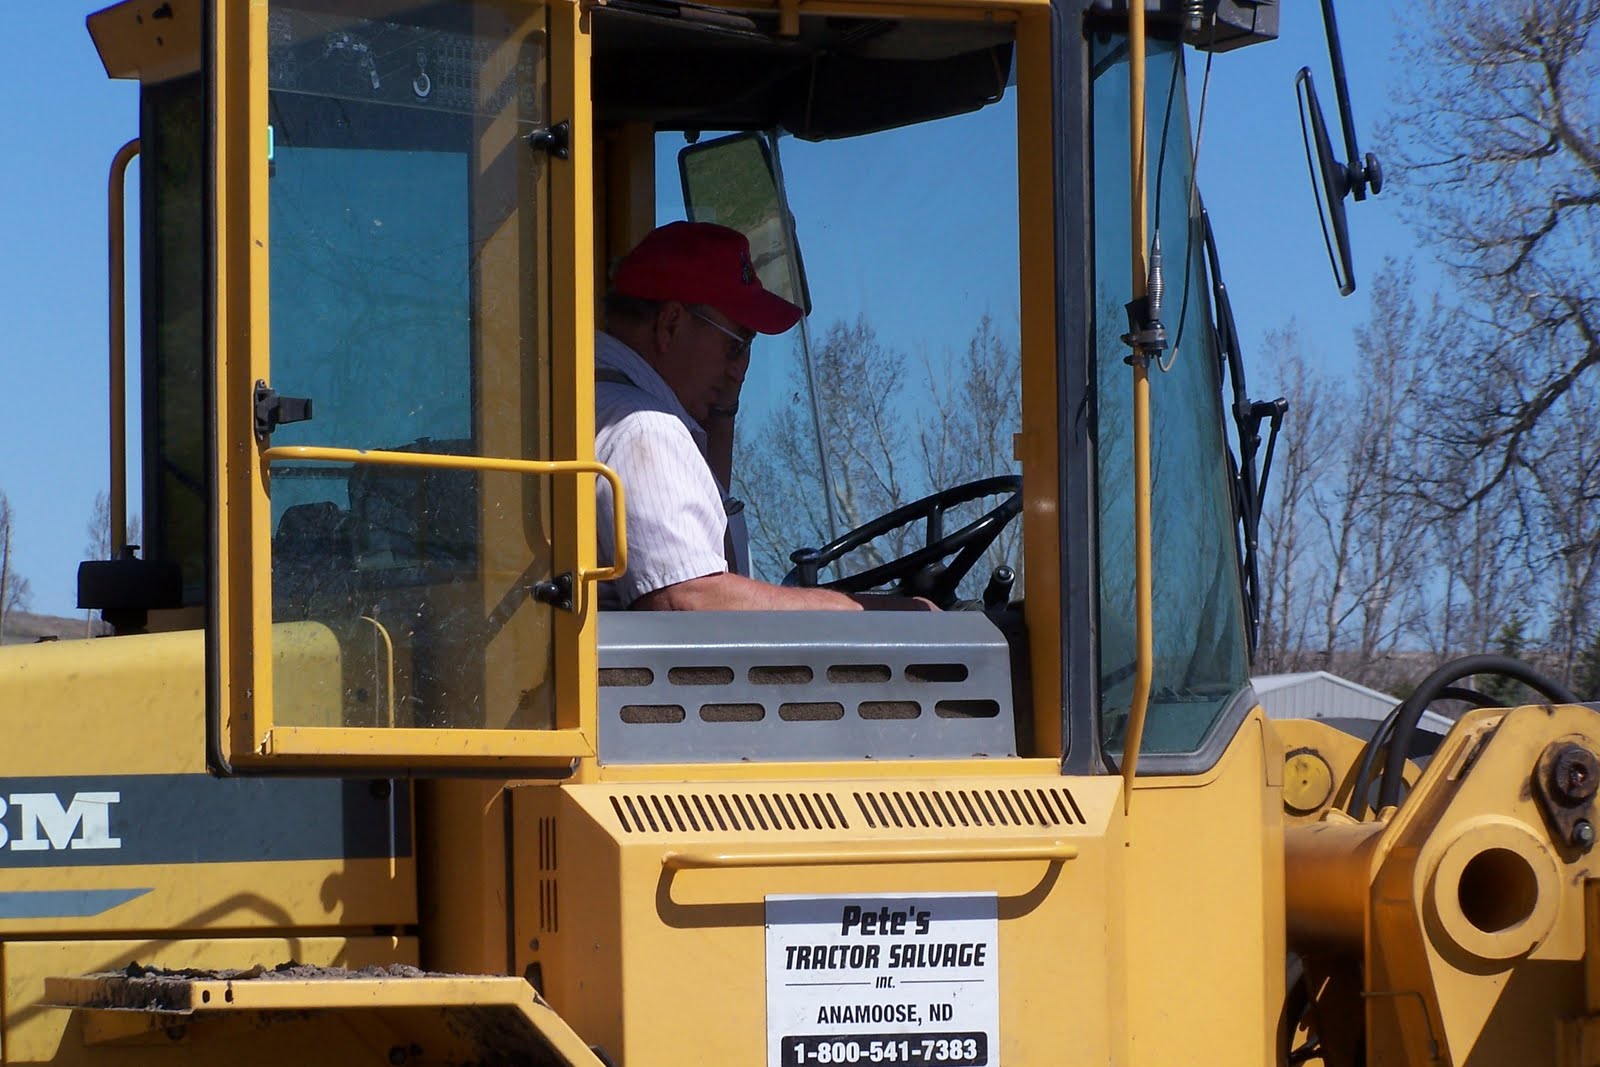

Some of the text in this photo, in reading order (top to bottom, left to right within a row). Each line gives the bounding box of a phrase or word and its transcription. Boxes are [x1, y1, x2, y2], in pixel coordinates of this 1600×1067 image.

[0, 791, 122, 850] M
[841, 905, 931, 936] Pete's
[785, 943, 987, 970] TRACTOR SALVAGE
[817, 1003, 954, 1026] ANAMOOSE, ND
[794, 1039, 978, 1064] 1-800-541-7383
